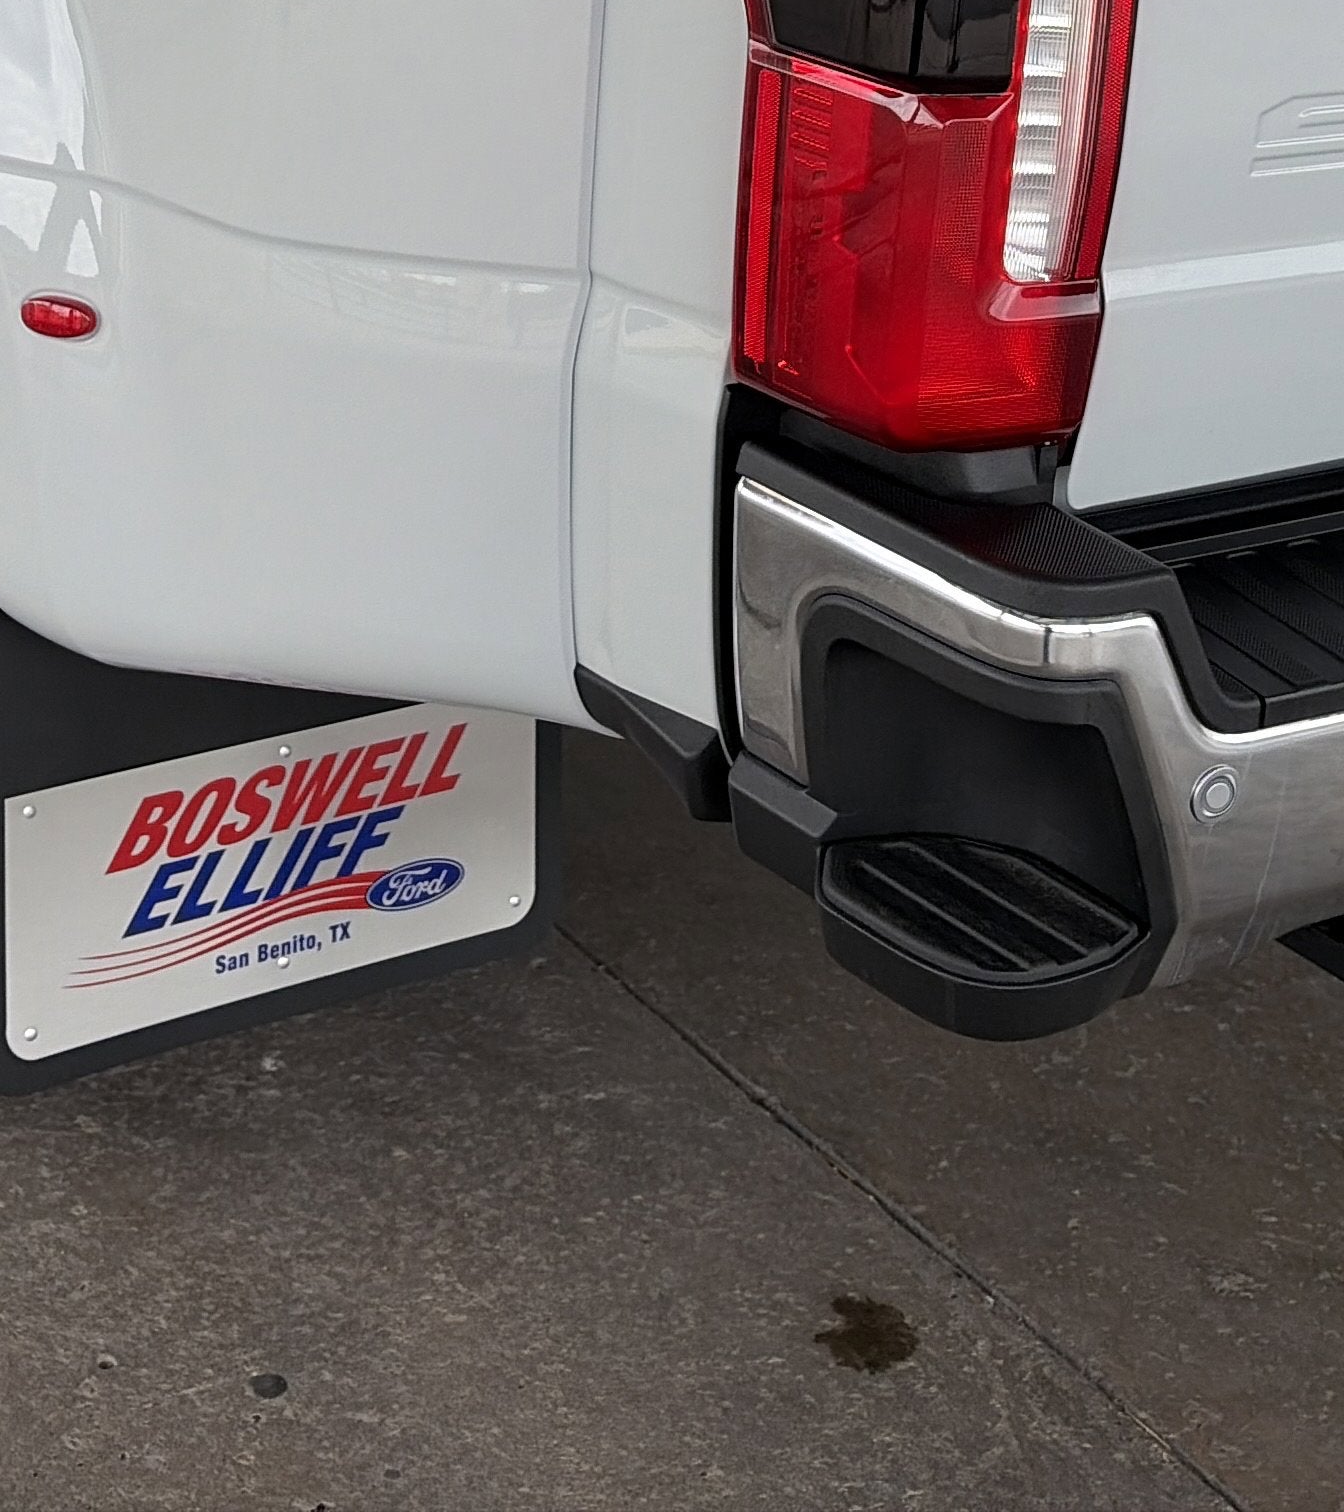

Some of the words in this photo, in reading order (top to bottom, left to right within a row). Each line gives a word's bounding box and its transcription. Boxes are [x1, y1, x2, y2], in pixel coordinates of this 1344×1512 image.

[105, 722, 468, 876] BOSWELL
[122, 804, 405, 939] ELLIFF
[214, 949, 250, 974] San
[257, 932, 323, 965] Benito,
[329, 920, 352, 944] TX
